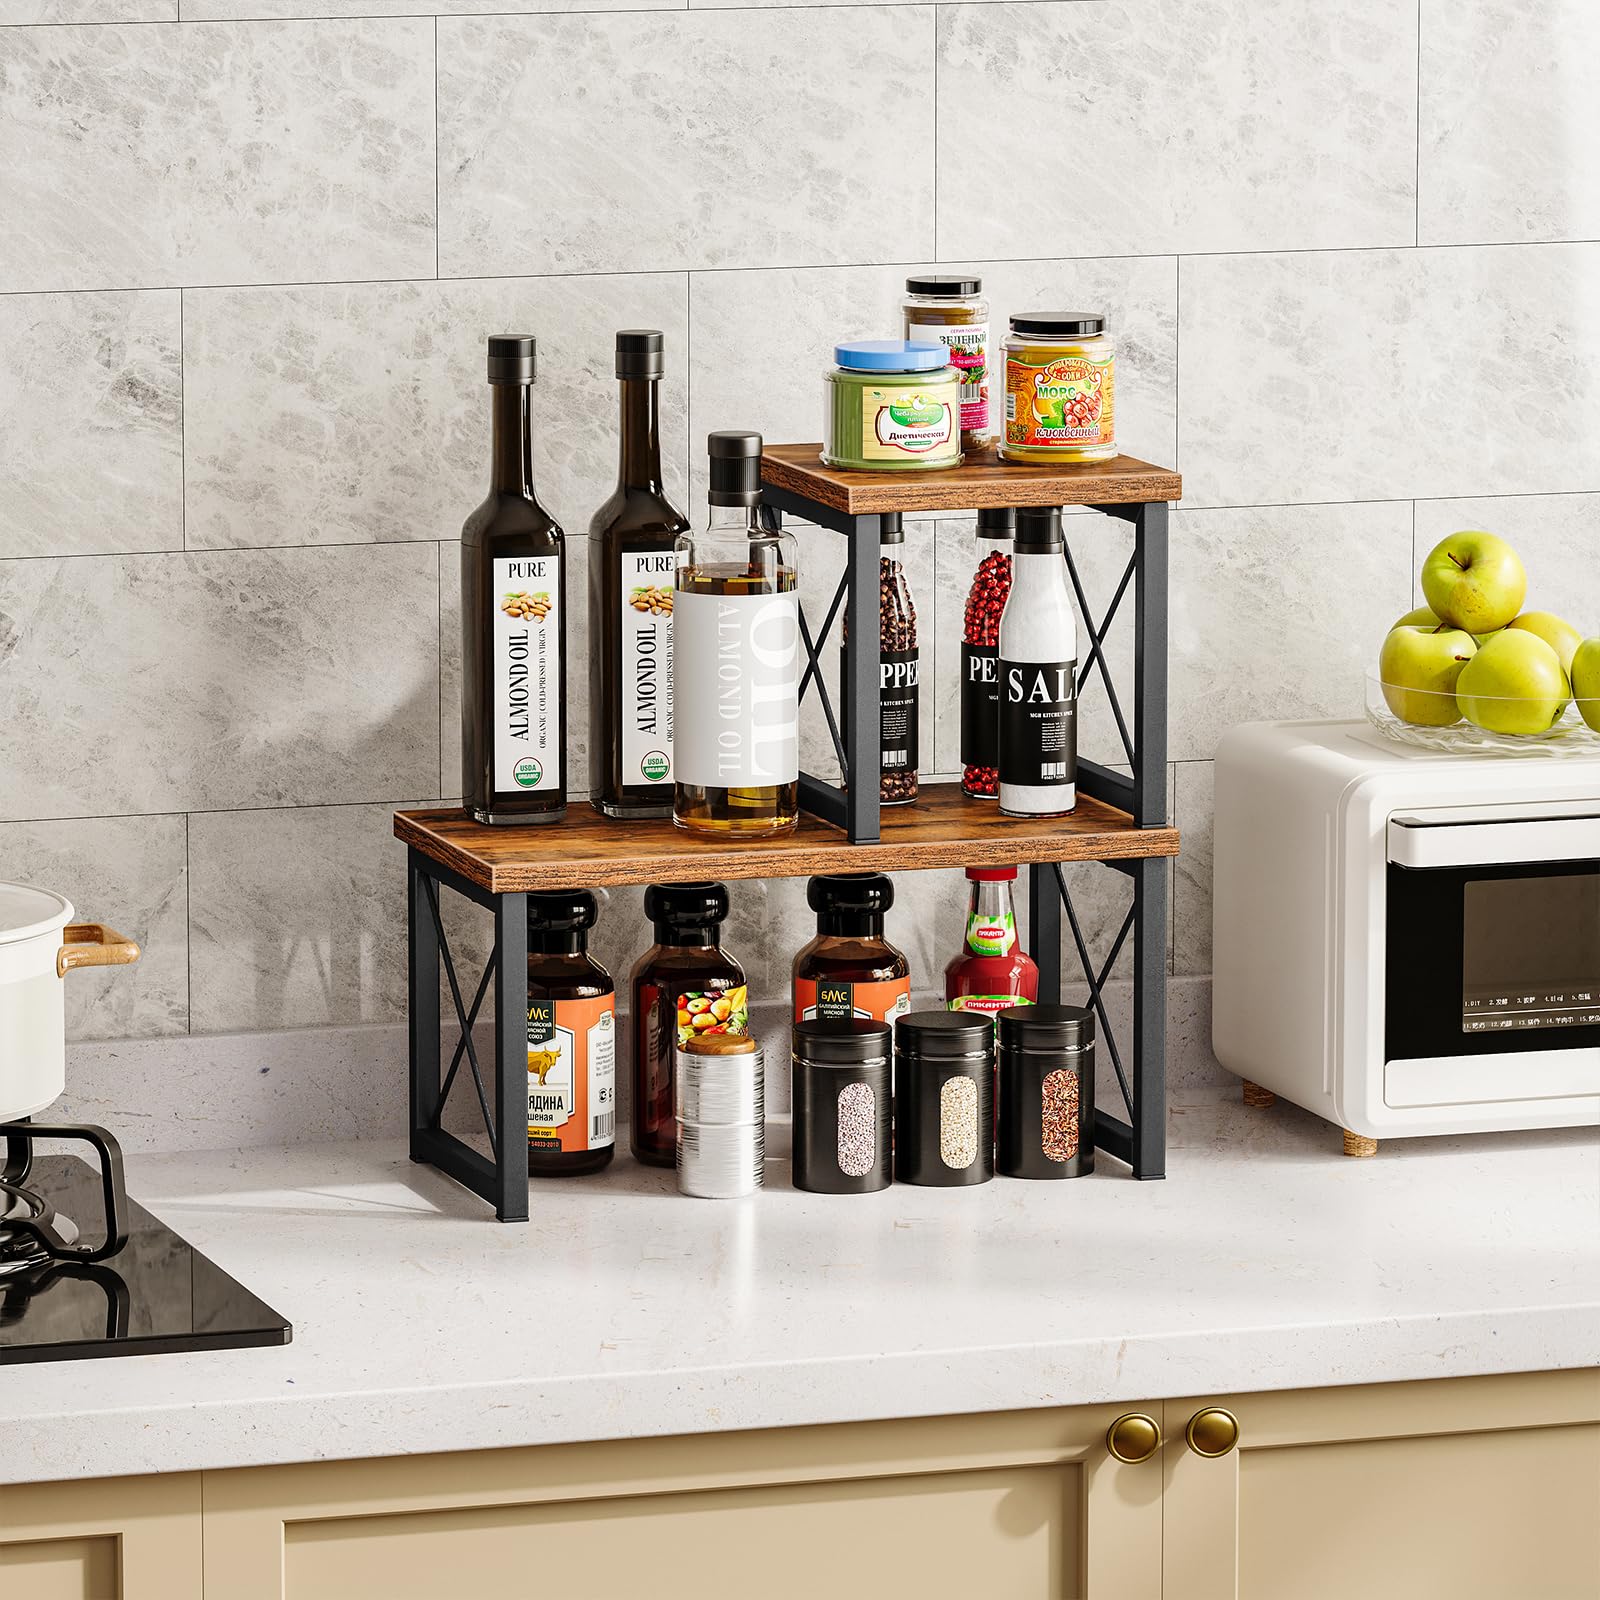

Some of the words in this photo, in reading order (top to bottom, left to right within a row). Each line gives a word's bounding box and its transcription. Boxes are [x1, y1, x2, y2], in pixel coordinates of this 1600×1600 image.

[939, 331, 987, 345] ЗЕЛЕНЫЙ
[1038, 387, 1076, 398] МОРС
[889, 432, 945, 440] Диетическая
[1036, 425, 1099, 437] клюквенный
[508, 562, 546, 578] PURE
[636, 556, 673, 573] PURE
[509, 629, 529, 660] OIL
[637, 623, 657, 654] OIL
[718, 602, 742, 720] ALMOND
[969, 656, 999, 683] PE
[880, 659, 919, 689] PPE
[637, 654, 657, 735] ALMOND
[750, 600, 797, 777] OIL
[509, 660, 529, 740] ALMOND
[718, 731, 742, 777] OIL
[518, 772, 539, 780] ORGANIC
[520, 764, 537, 772] USDA
[528, 1095, 564, 1112] ЯДИНА
[527, 1113, 554, 1122] шеная
